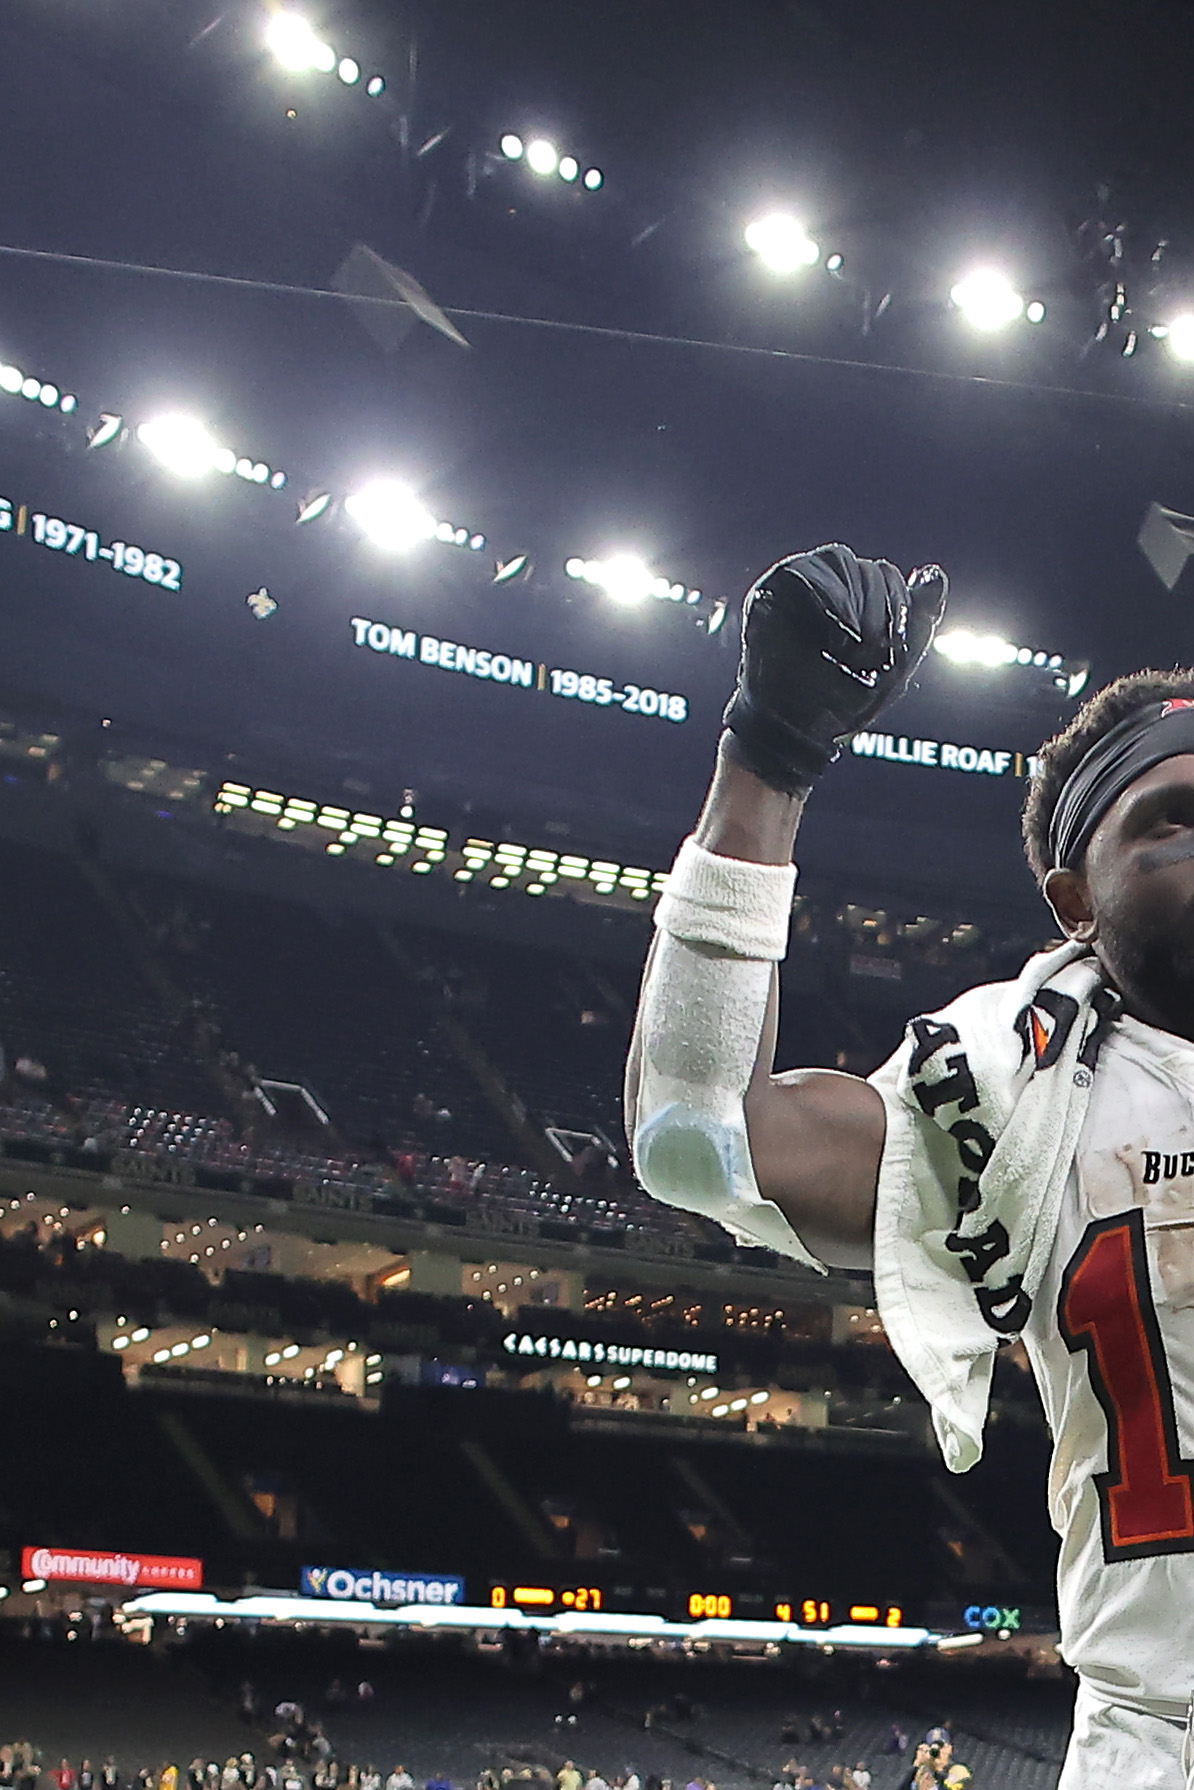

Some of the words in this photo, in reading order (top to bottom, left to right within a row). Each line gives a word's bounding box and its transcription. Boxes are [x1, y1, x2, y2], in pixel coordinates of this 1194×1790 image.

[31, 512, 183, 593] 1971-1982
[350, 617, 417, 660] TOM
[420, 635, 534, 688] BENSON
[550, 668, 689, 723] 1985-2018
[851, 732, 939, 767] WILLIE
[941, 744, 1014, 776] ROAF
[606, 1344, 719, 1373] SUPERDOME
[31, 1548, 140, 1586] Community
[326, 1570, 459, 1604] Ochsner
[776, 1603, 793, 1622] 4
[886, 1606, 903, 1628] 2
[963, 1605, 1021, 1630] COX
